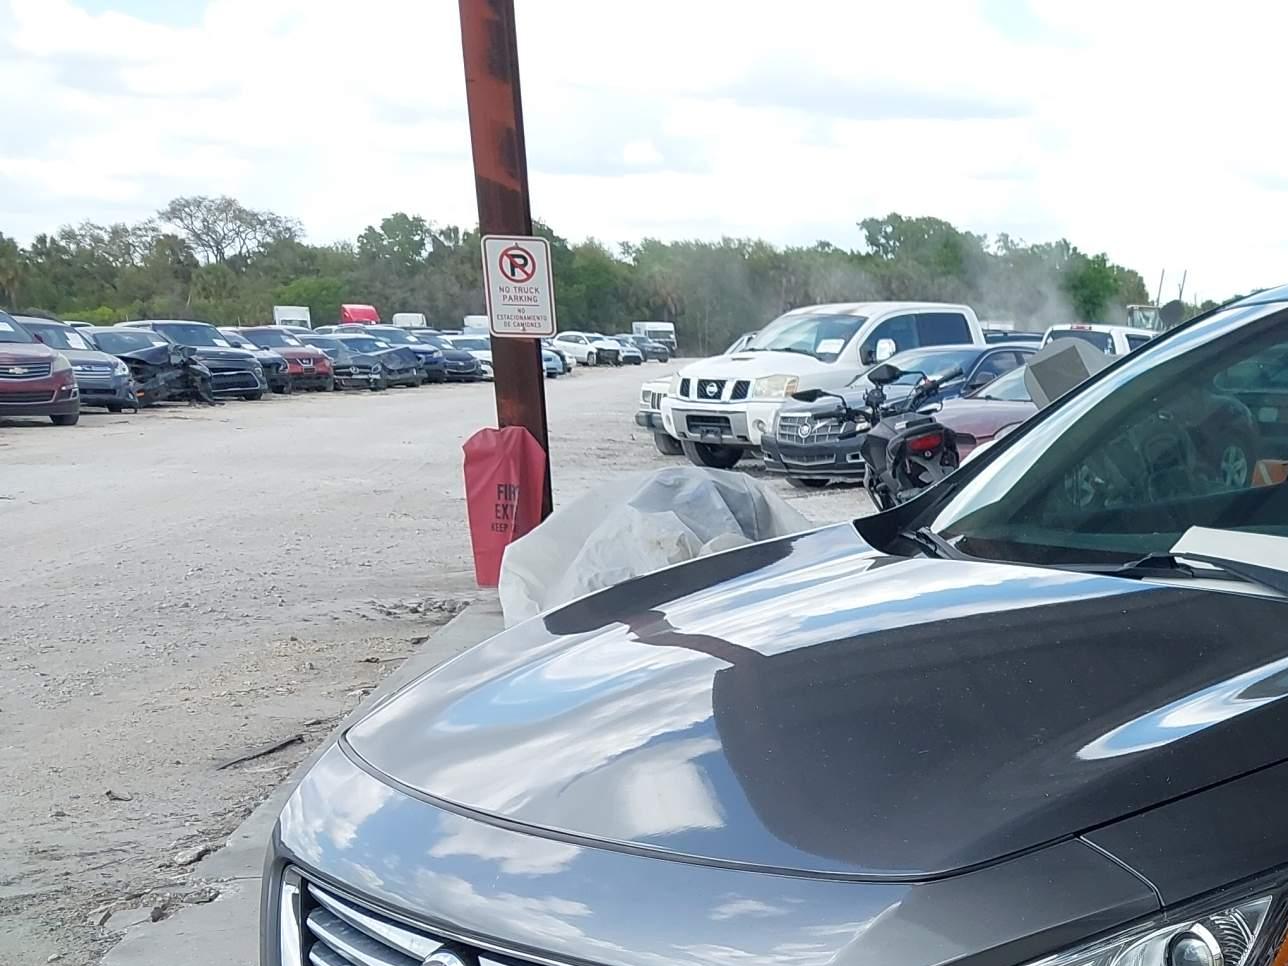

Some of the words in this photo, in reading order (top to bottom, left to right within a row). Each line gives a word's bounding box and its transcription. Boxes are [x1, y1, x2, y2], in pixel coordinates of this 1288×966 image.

[509, 254, 529, 277] P
[499, 286, 510, 294] NO
[513, 286, 540, 294] TRUCK
[502, 295, 538, 303] PARKING
